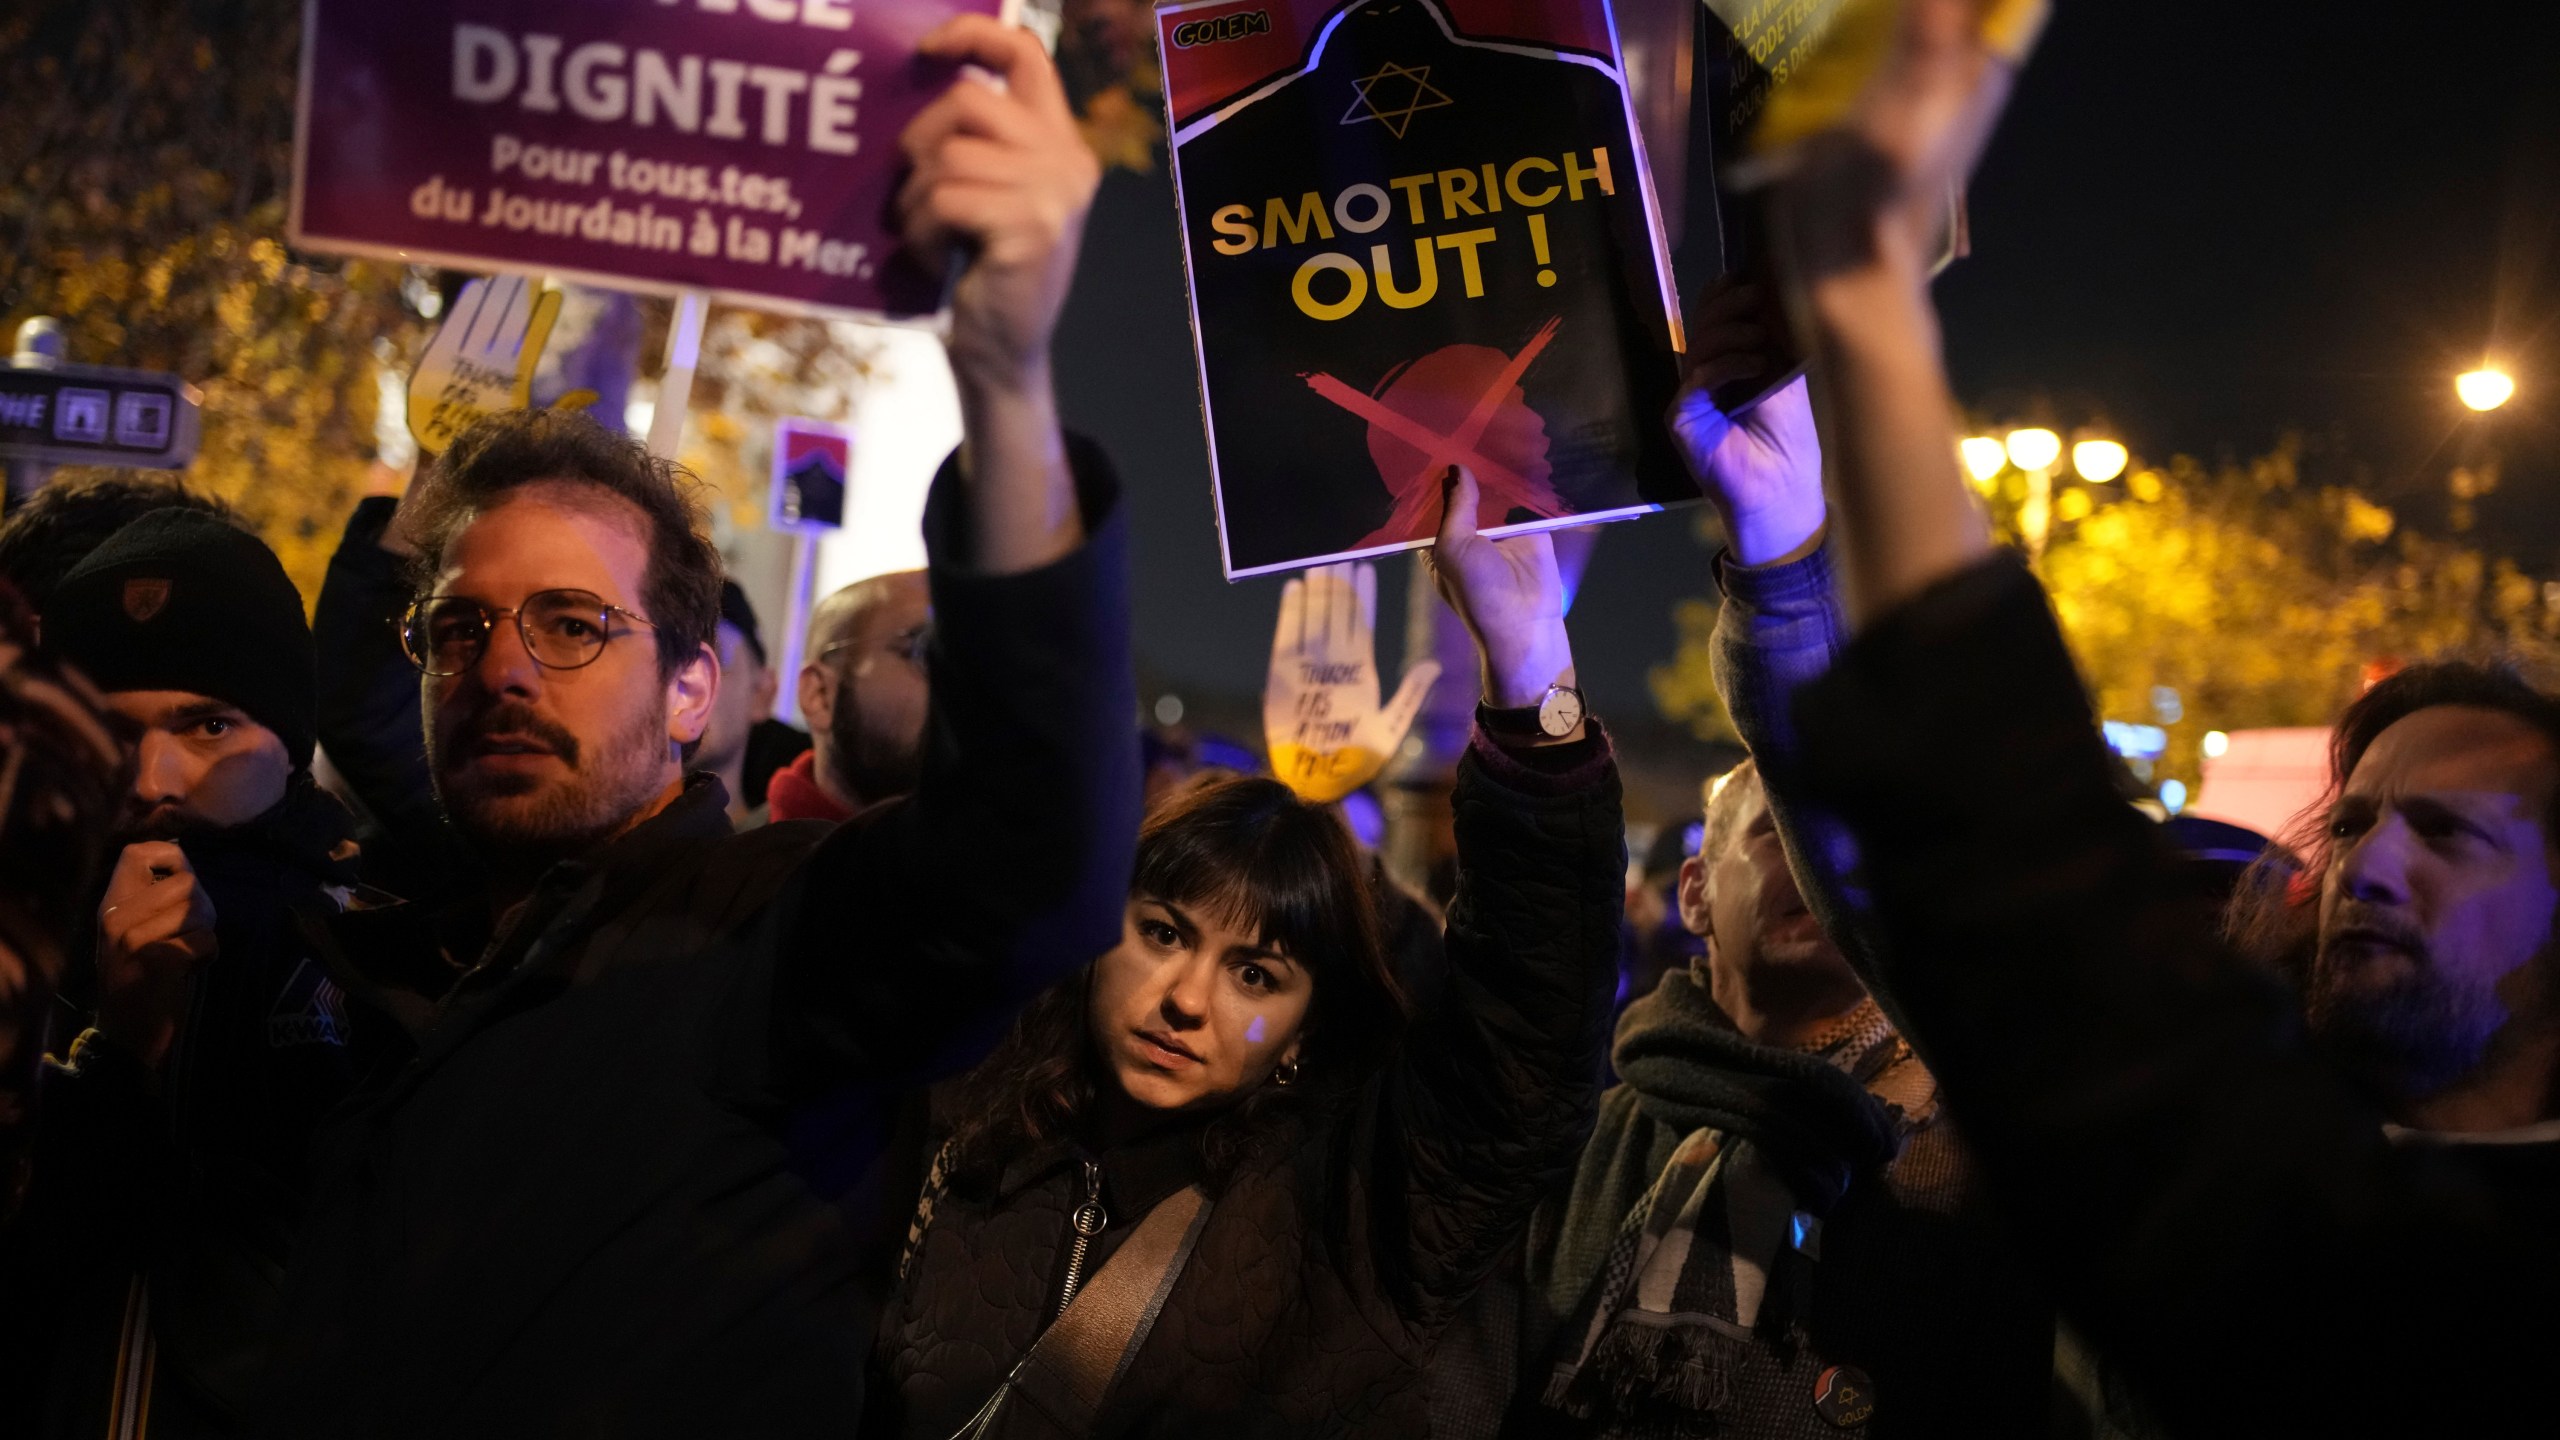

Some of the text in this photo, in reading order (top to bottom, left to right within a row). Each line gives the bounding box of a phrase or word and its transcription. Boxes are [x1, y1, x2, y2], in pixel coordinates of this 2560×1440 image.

[1178, 13, 1267, 46] GOLEM
[452, 24, 862, 155] DIGNITÉ
[411, 176, 874, 280] du Jourdain à la Mer.
[491, 134, 803, 219] Pour tous.tes,
[1211, 146, 1615, 256] SMOTRICH
[1291, 213, 1557, 321] OUT !
[1838, 1404, 1873, 1426] GOLEM
